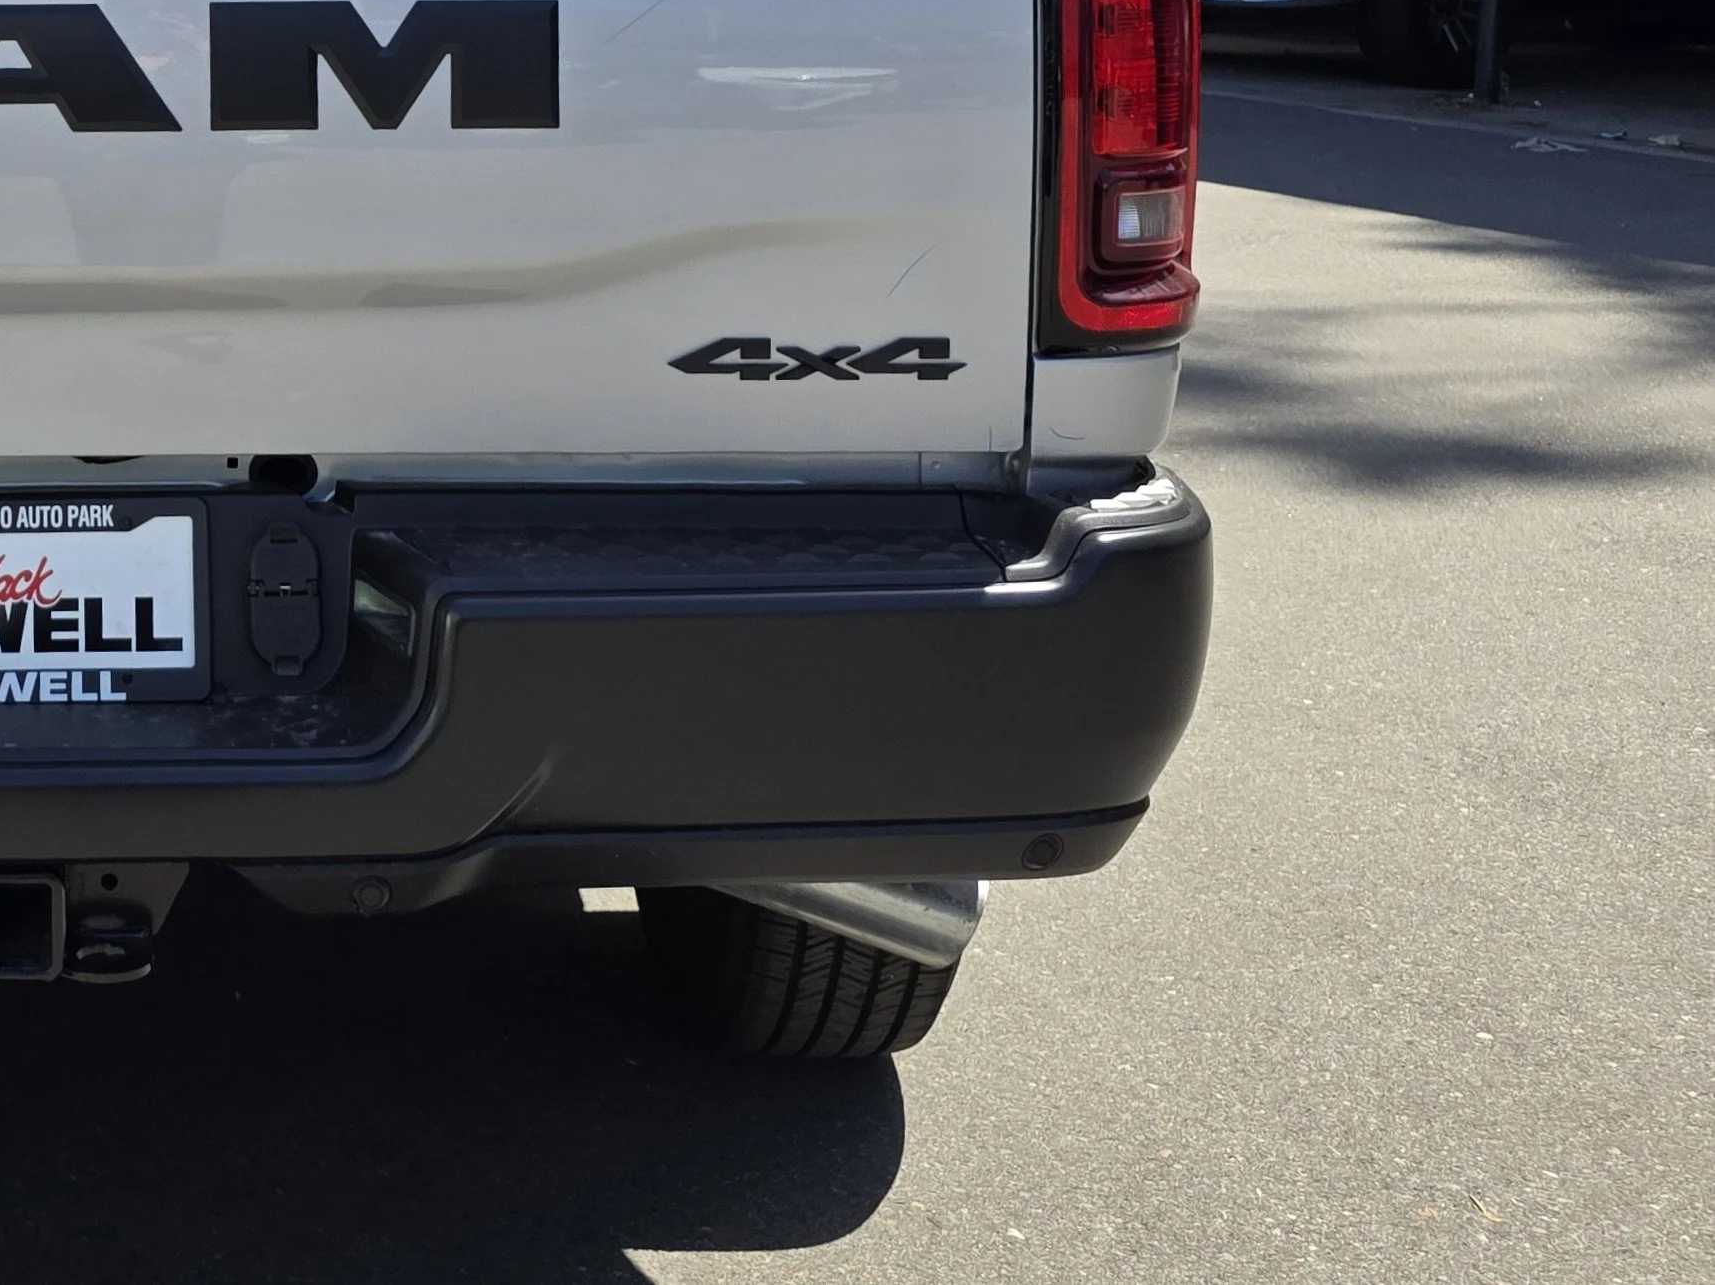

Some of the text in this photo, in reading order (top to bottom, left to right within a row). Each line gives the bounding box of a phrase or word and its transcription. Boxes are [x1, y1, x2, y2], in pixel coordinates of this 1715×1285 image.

[667, 337, 968, 381] 4x4
[16, 505, 63, 530] AUTO
[67, 504, 115, 528] PARK
